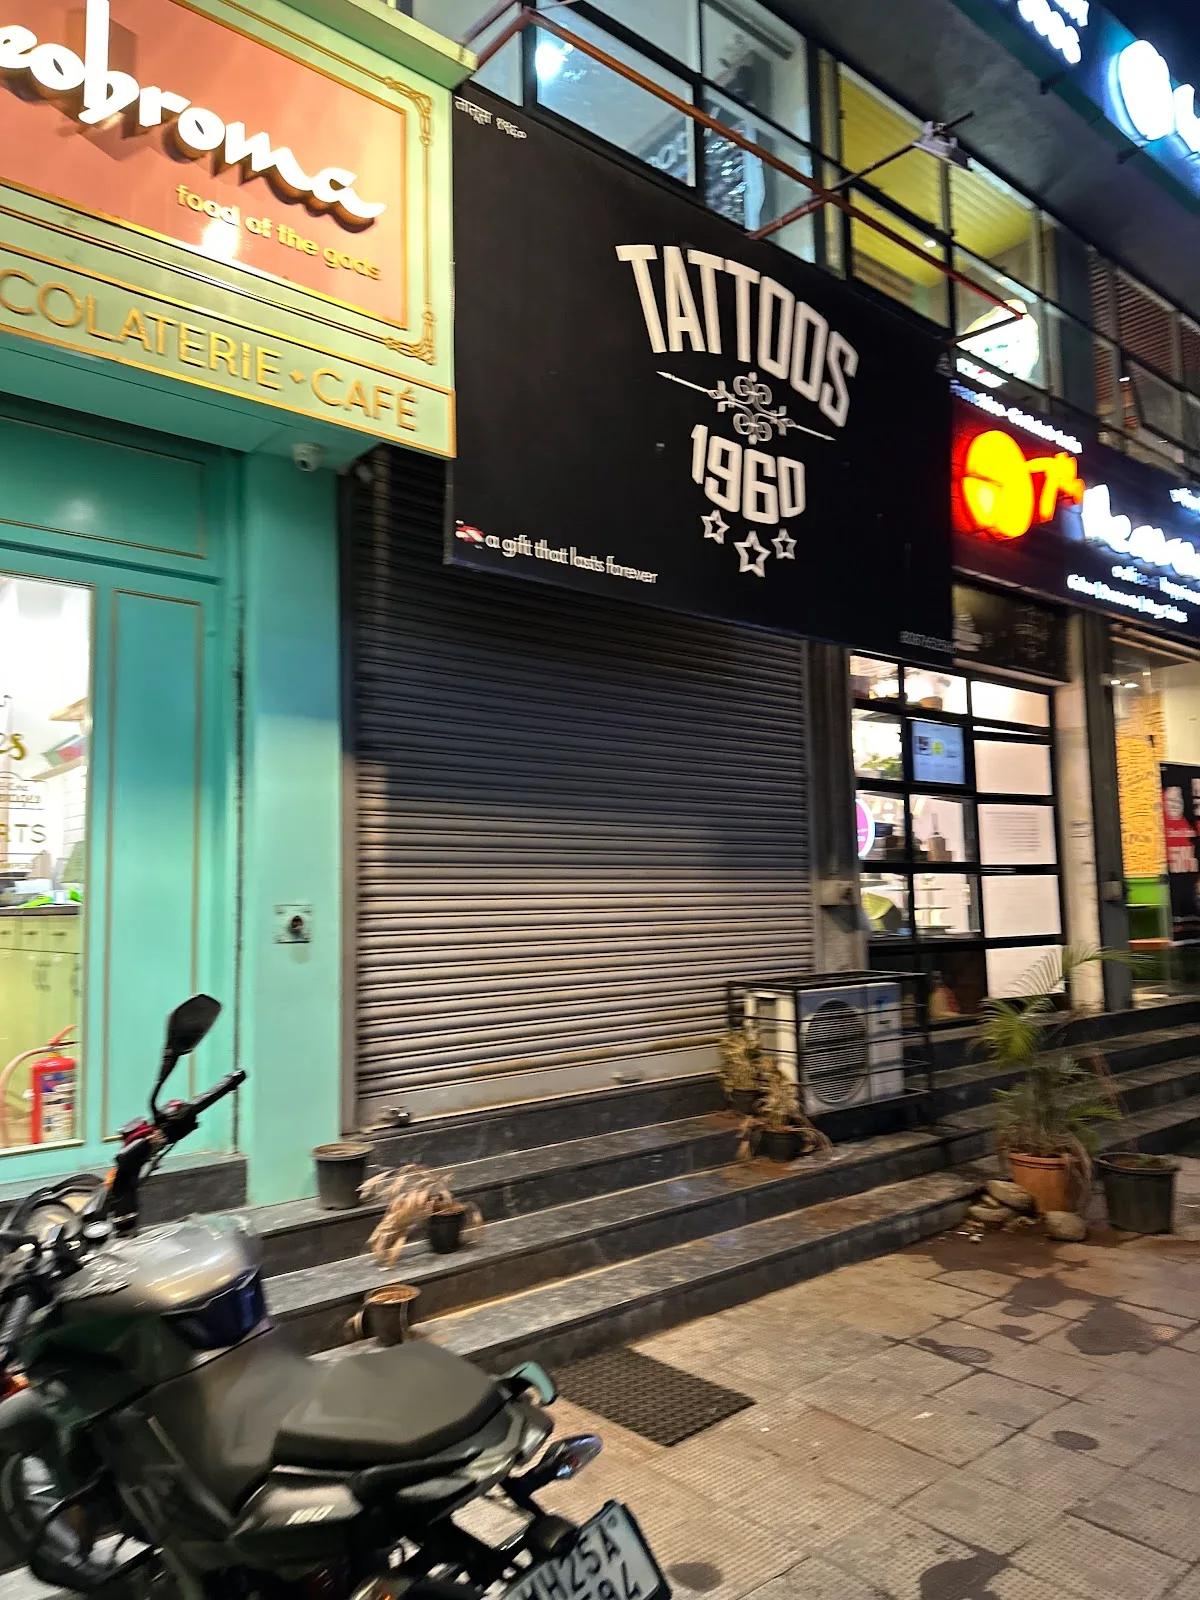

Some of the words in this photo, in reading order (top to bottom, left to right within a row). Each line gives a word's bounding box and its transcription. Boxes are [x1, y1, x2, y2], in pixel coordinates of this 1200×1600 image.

[176, 185, 240, 227] food
[245, 215, 272, 240] of
[276, 222, 317, 256] the
[322, 244, 382, 281] gods
[616, 243, 859, 427] TATTOOS
[311, 367, 420, 432] CAFÉ
[690, 423, 806, 524] 1960
[485, 534, 500, 549] a
[502, 534, 534, 557] gift
[534, 539, 569, 565] that
[569, 546, 605, 573] lasts
[605, 555, 659, 584] forever
